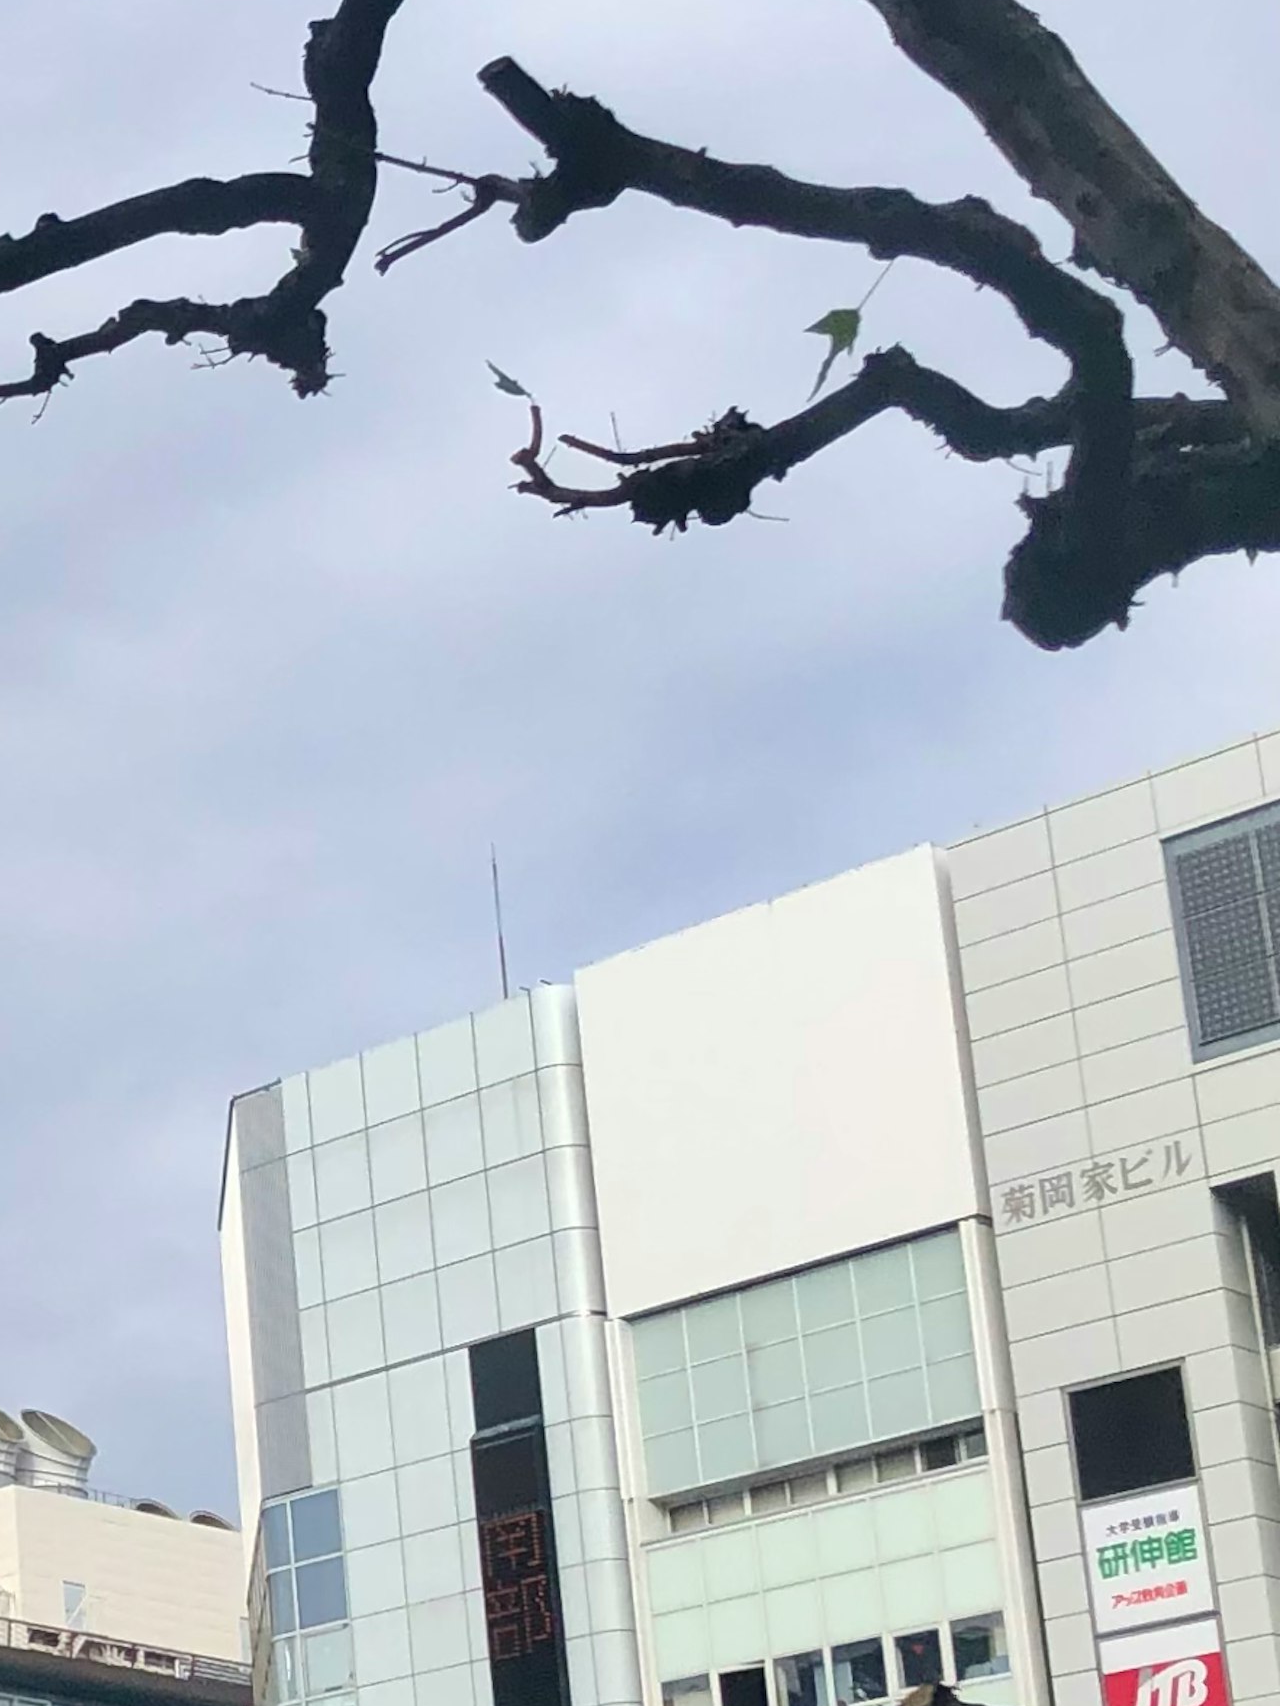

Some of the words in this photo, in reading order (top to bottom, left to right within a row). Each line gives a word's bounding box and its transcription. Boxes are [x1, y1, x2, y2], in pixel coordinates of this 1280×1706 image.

[1000, 1140, 1193, 1226] 菊岡家ビル
[1096, 1528, 1198, 1580] 研伸館
